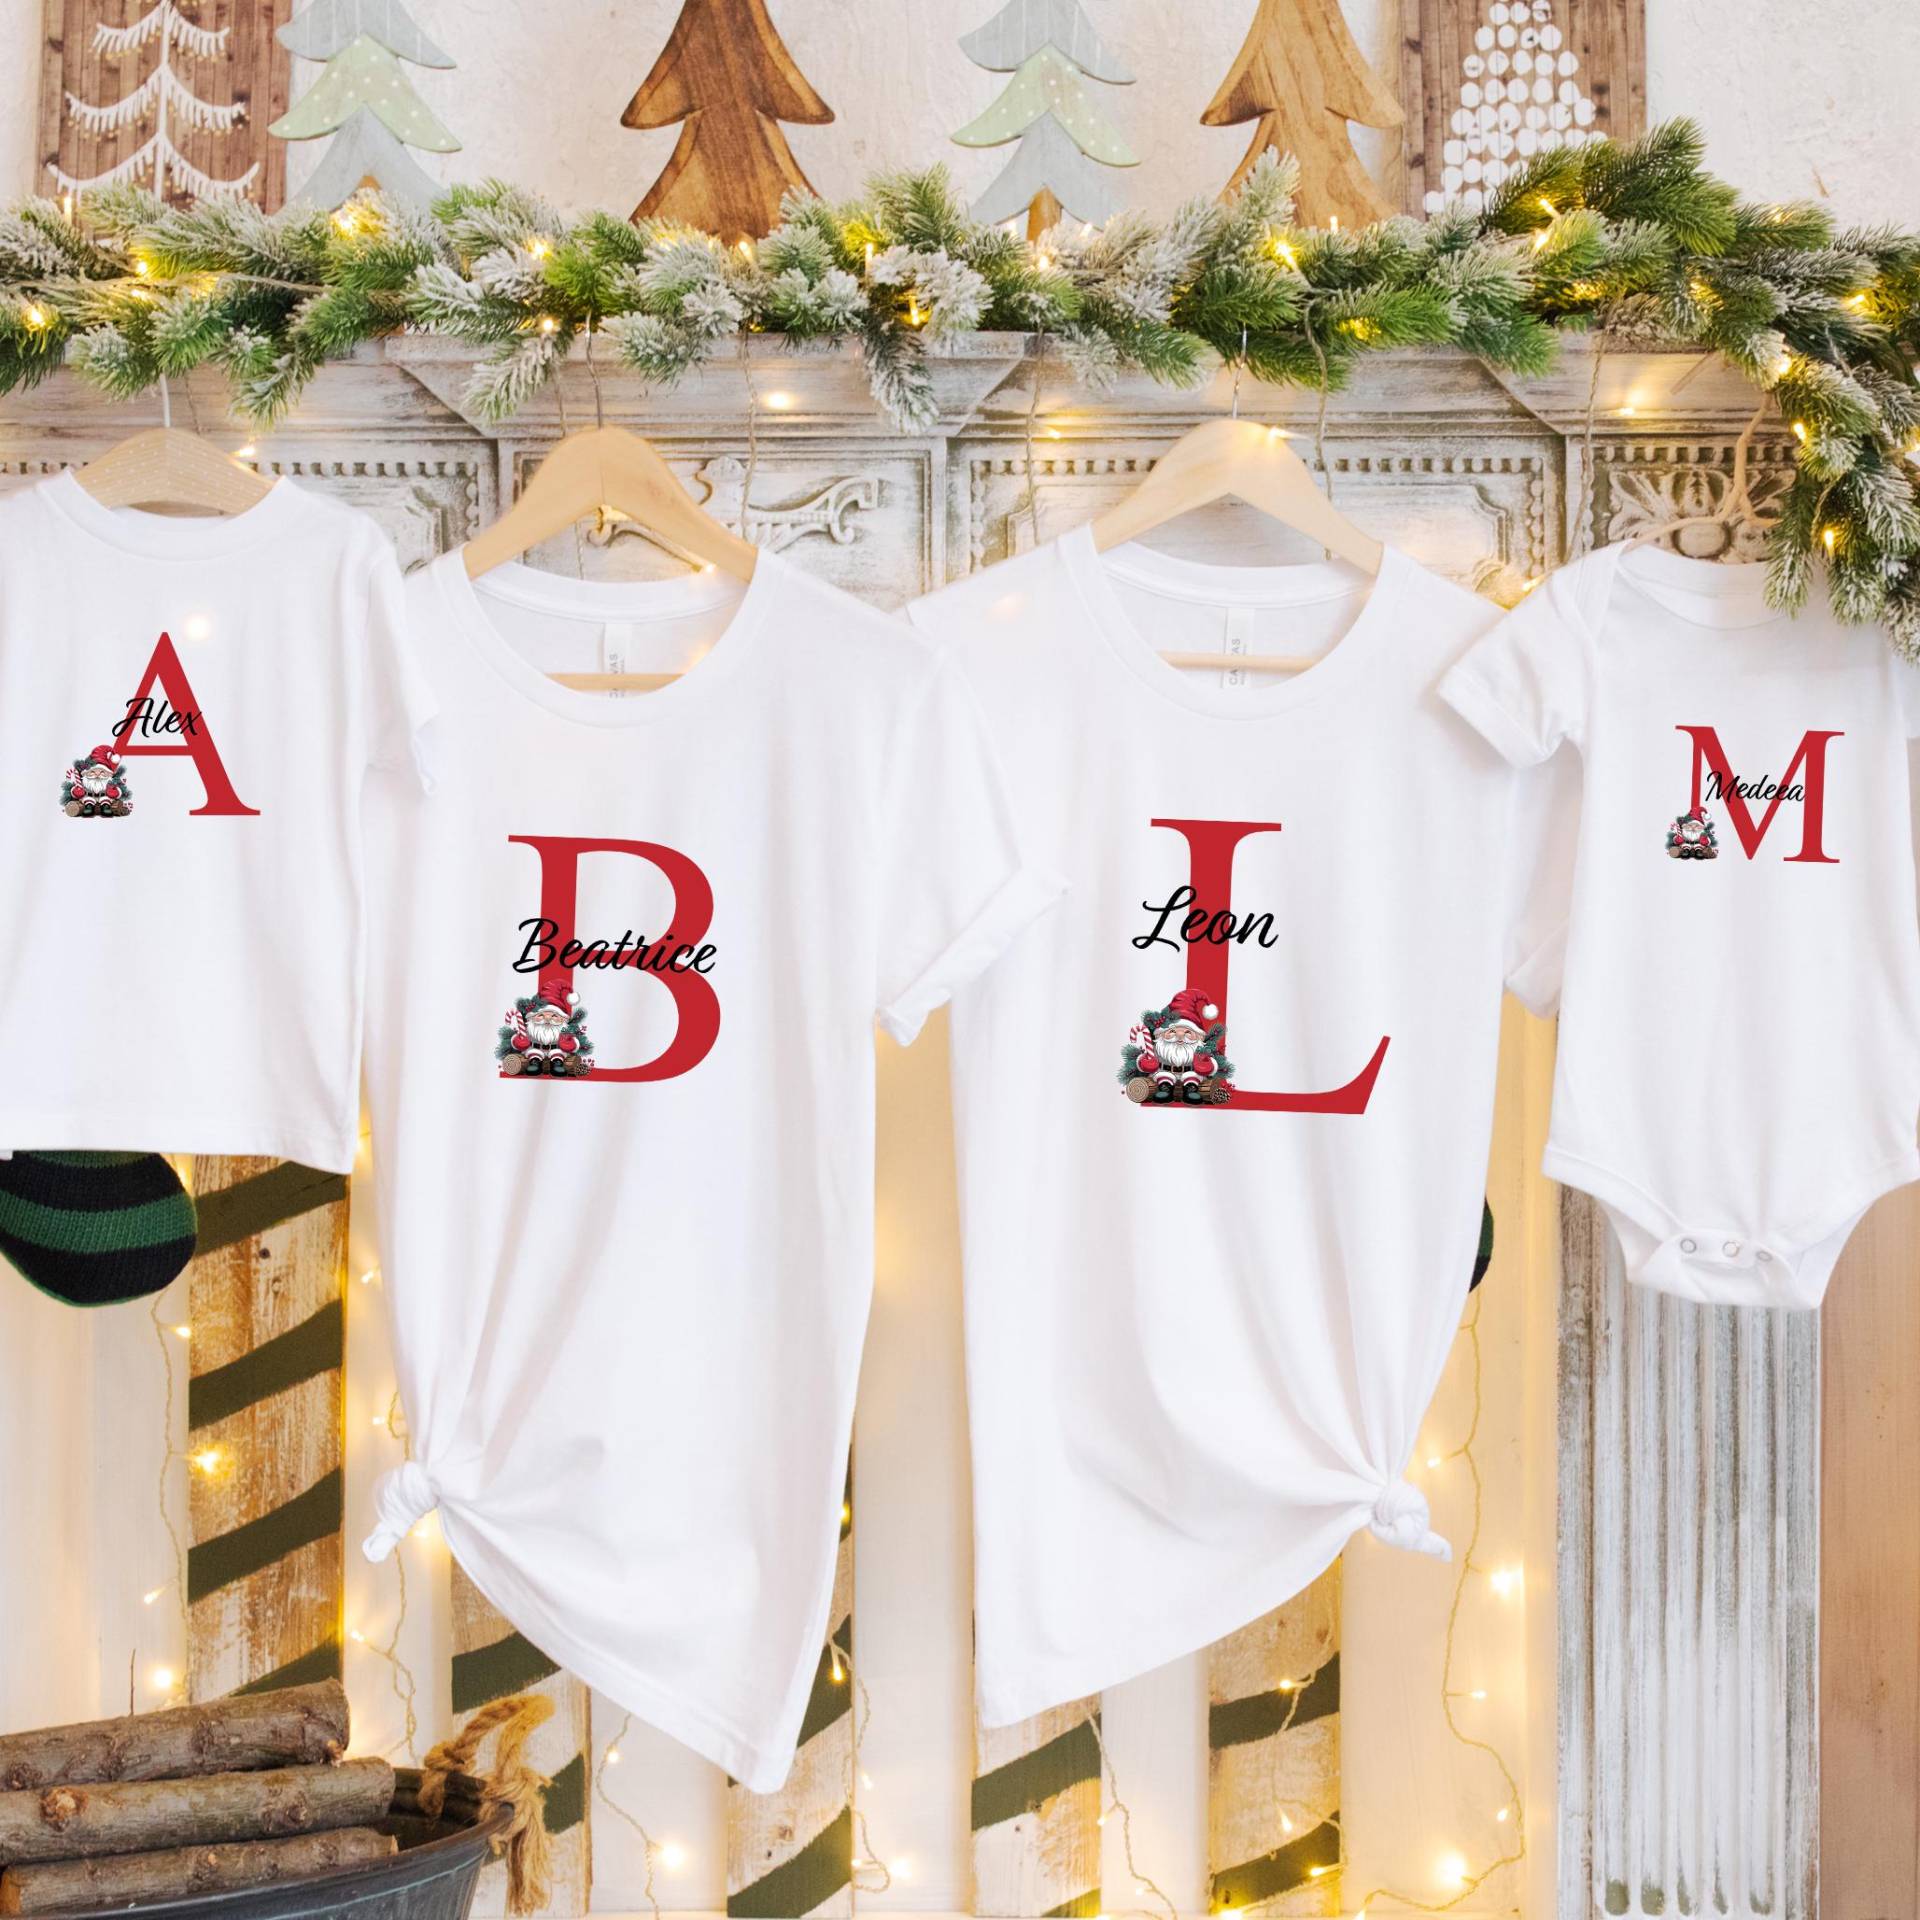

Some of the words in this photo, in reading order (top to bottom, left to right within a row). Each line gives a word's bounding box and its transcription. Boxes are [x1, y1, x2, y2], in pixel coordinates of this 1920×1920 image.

[110, 632, 261, 816] A
[112, 697, 202, 738] Alex
[1675, 725, 1845, 864] M
[1705, 771, 1806, 803] Medeea
[499, 835, 721, 1083] B
[512, 918, 717, 974] Beatrice
[1131, 886, 1279, 953] Leon
[1141, 818, 1391, 1115] L
